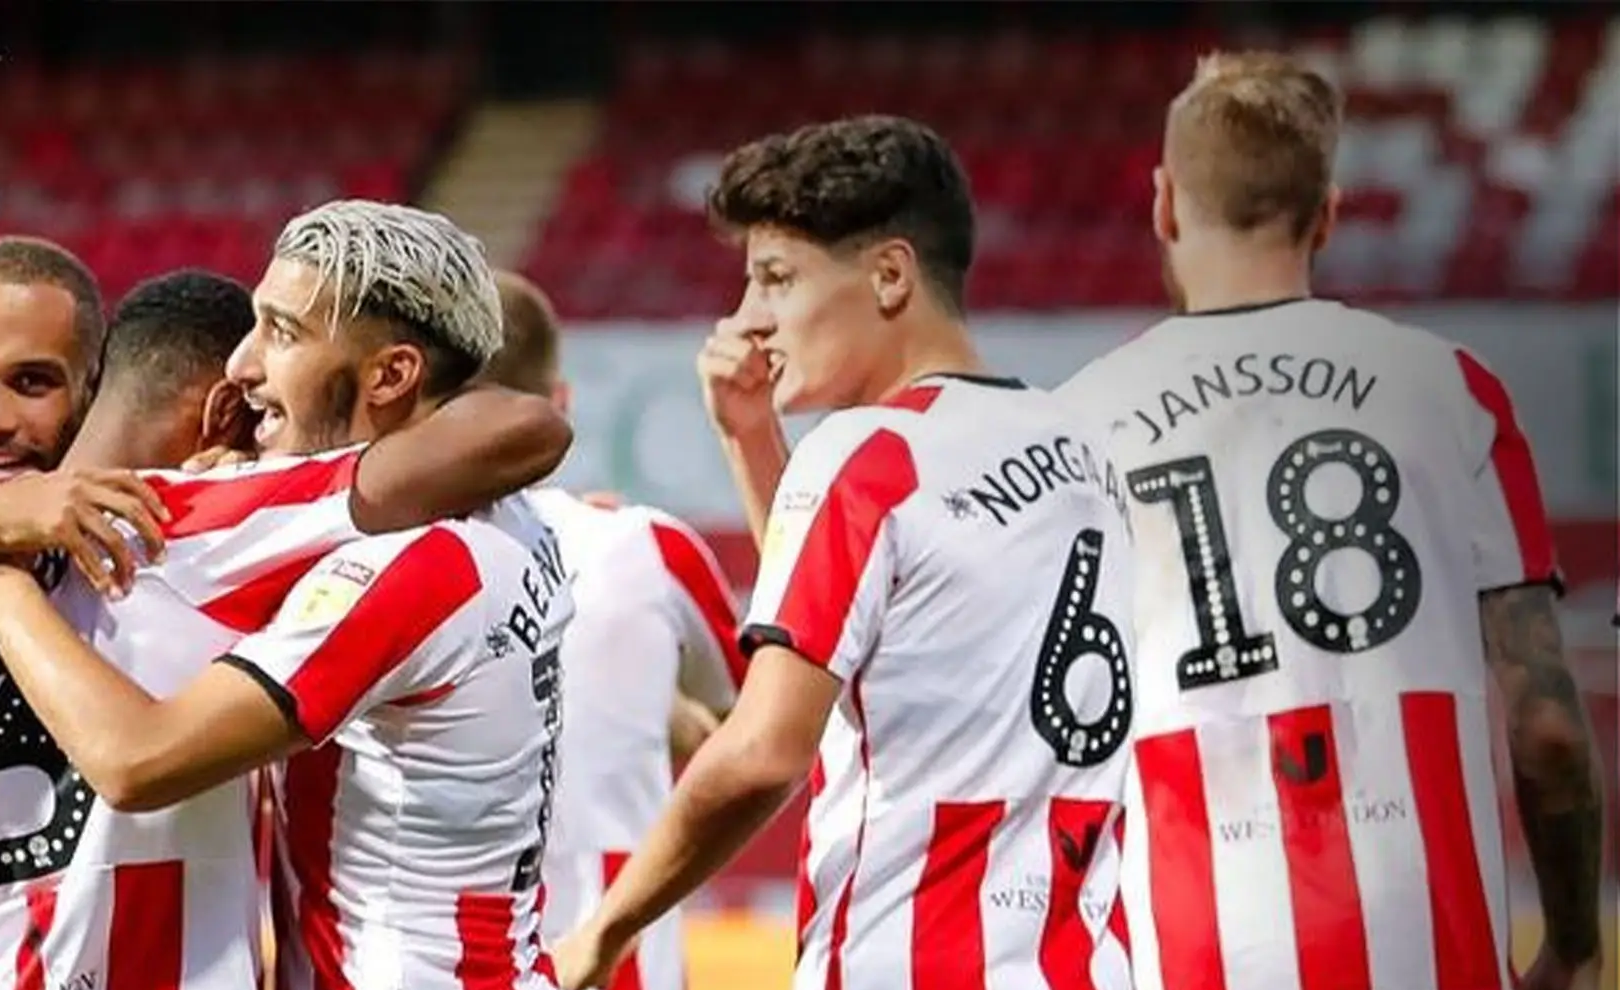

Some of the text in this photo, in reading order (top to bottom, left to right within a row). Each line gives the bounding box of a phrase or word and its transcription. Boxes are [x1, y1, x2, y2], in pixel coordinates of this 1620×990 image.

[1134, 353, 1377, 443] JANSSON
[1030, 527, 1133, 768] 6
[1126, 428, 1423, 690] 18
